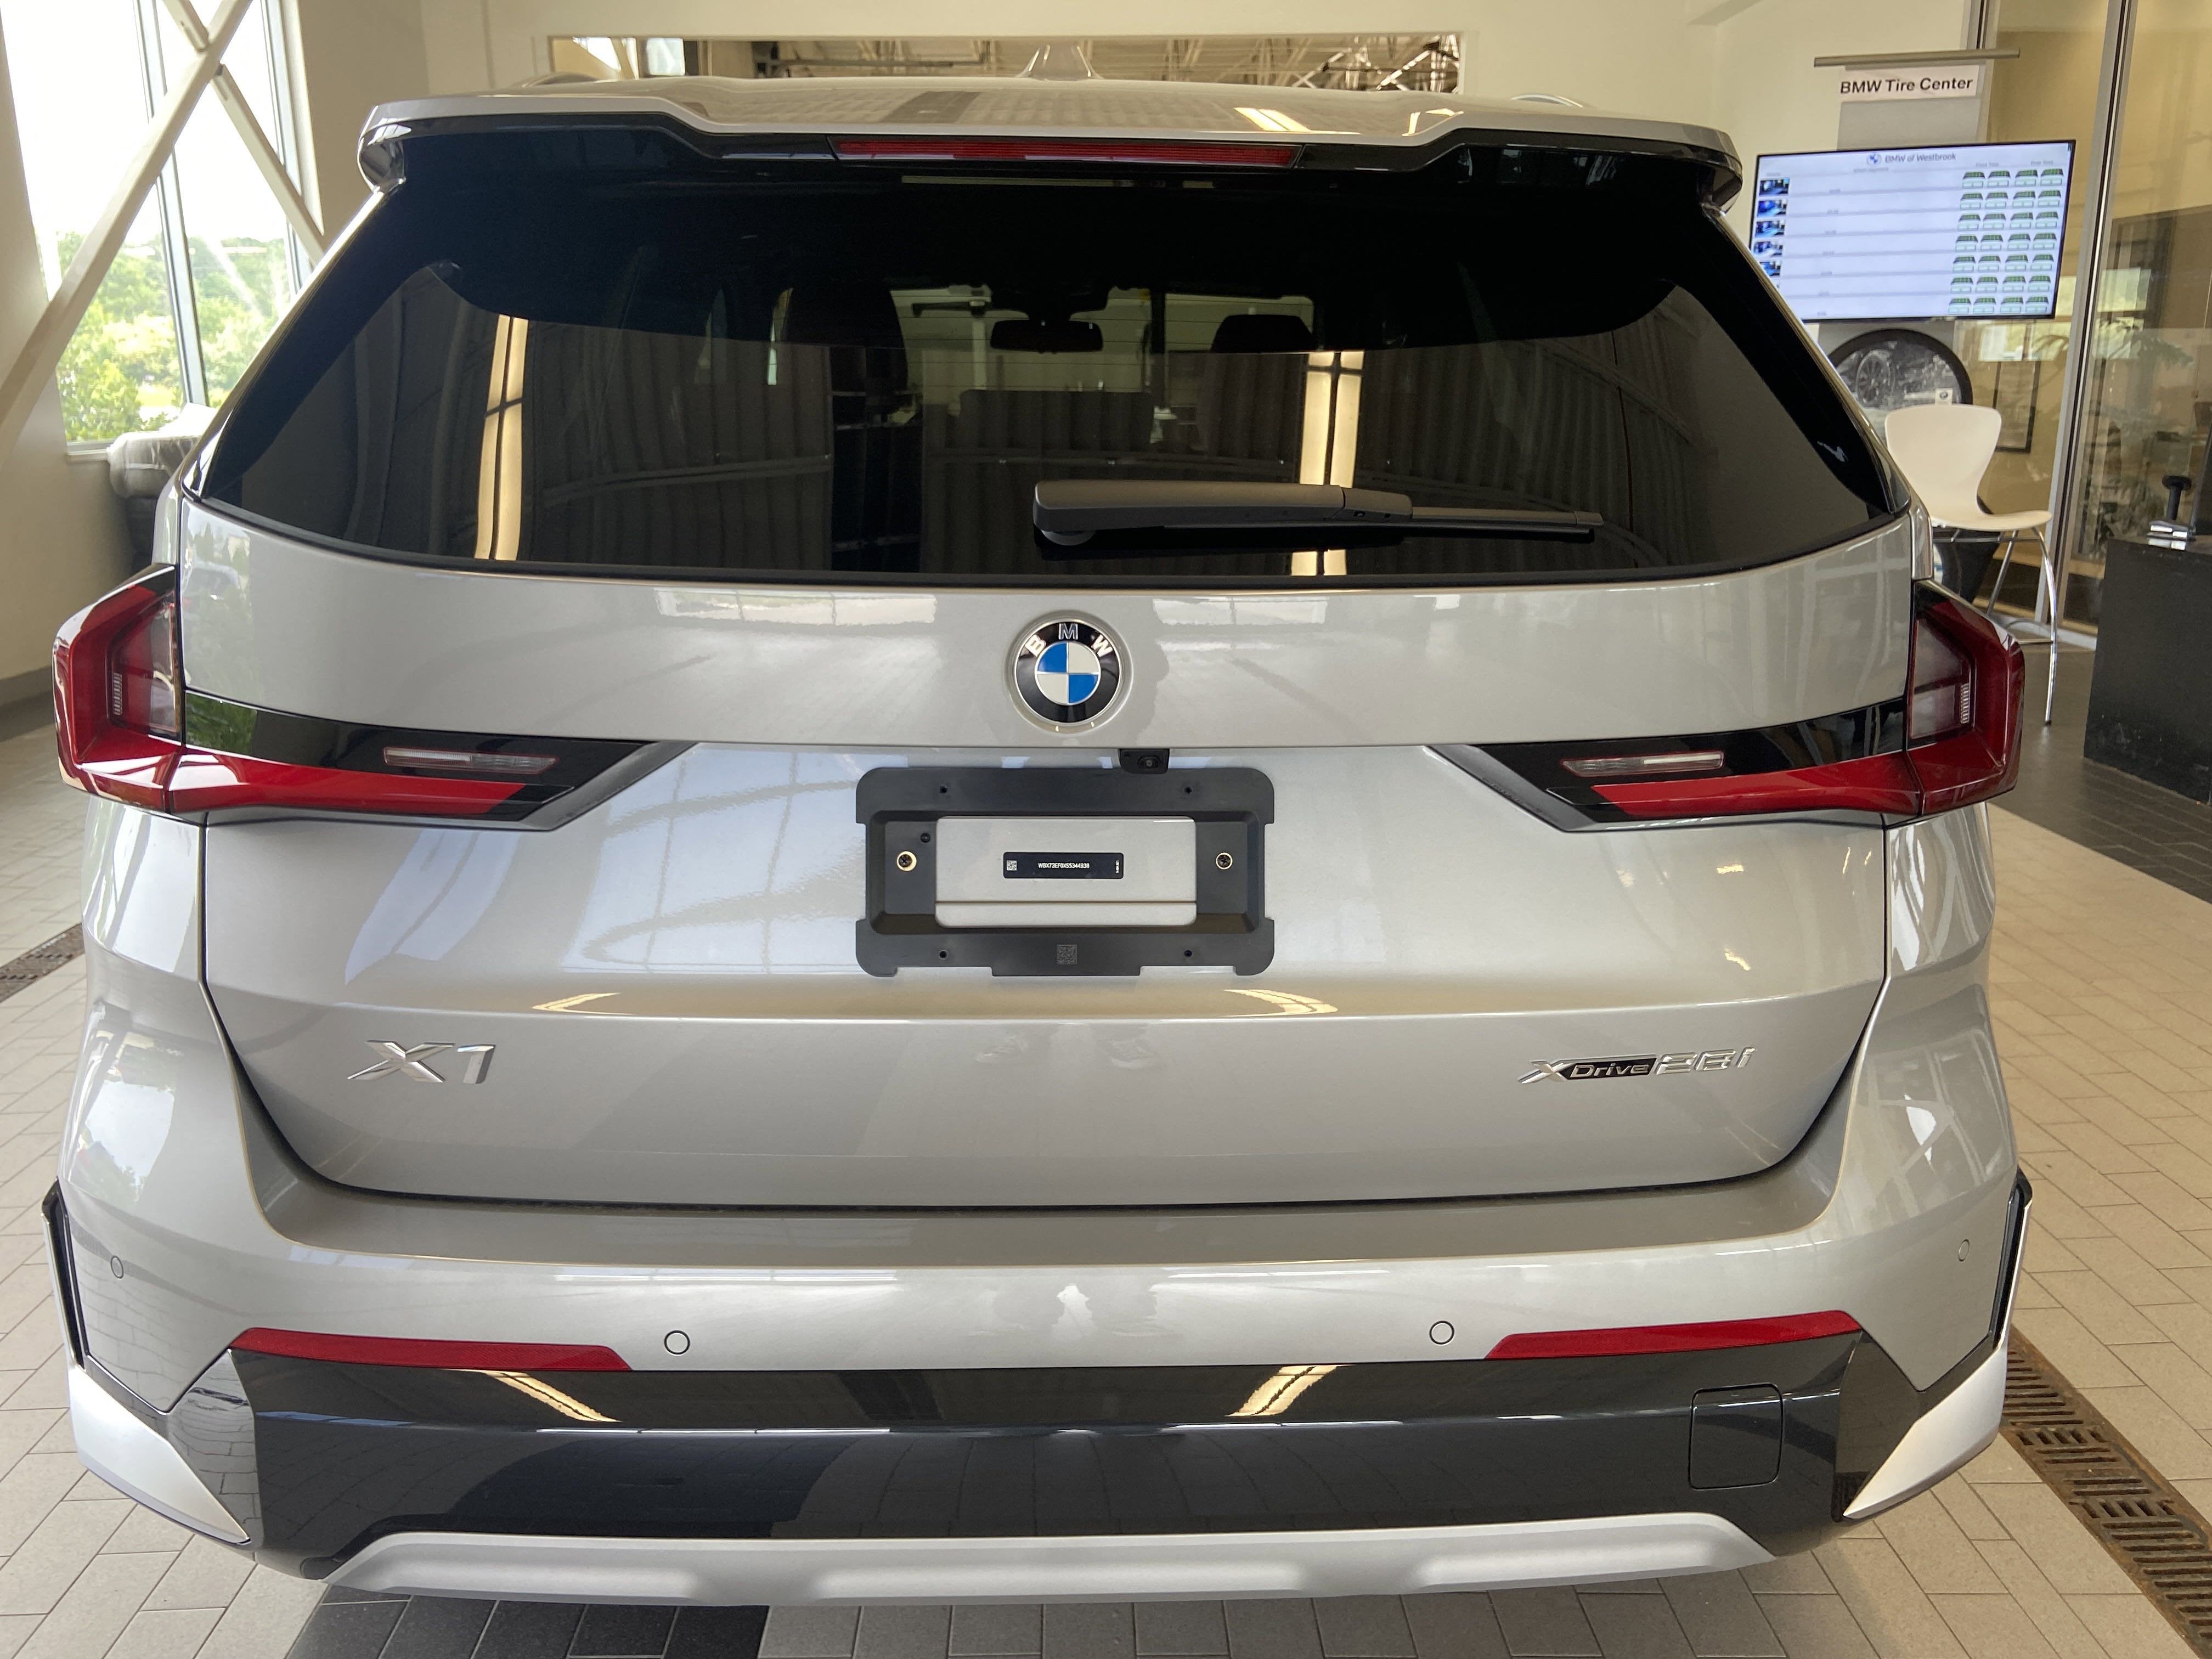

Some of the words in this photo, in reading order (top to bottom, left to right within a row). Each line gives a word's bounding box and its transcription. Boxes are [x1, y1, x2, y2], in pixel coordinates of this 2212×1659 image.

[1840, 80, 1881, 94] BMW
[1886, 80, 1915, 93] Tire
[1920, 77, 1973, 91] Center
[1885, 155, 1906, 163] BMW
[1908, 154, 1915, 163] of
[1916, 153, 1956, 162] Westbrook
[1025, 623, 1113, 658] BMW
[347, 1040, 496, 1084] X1
